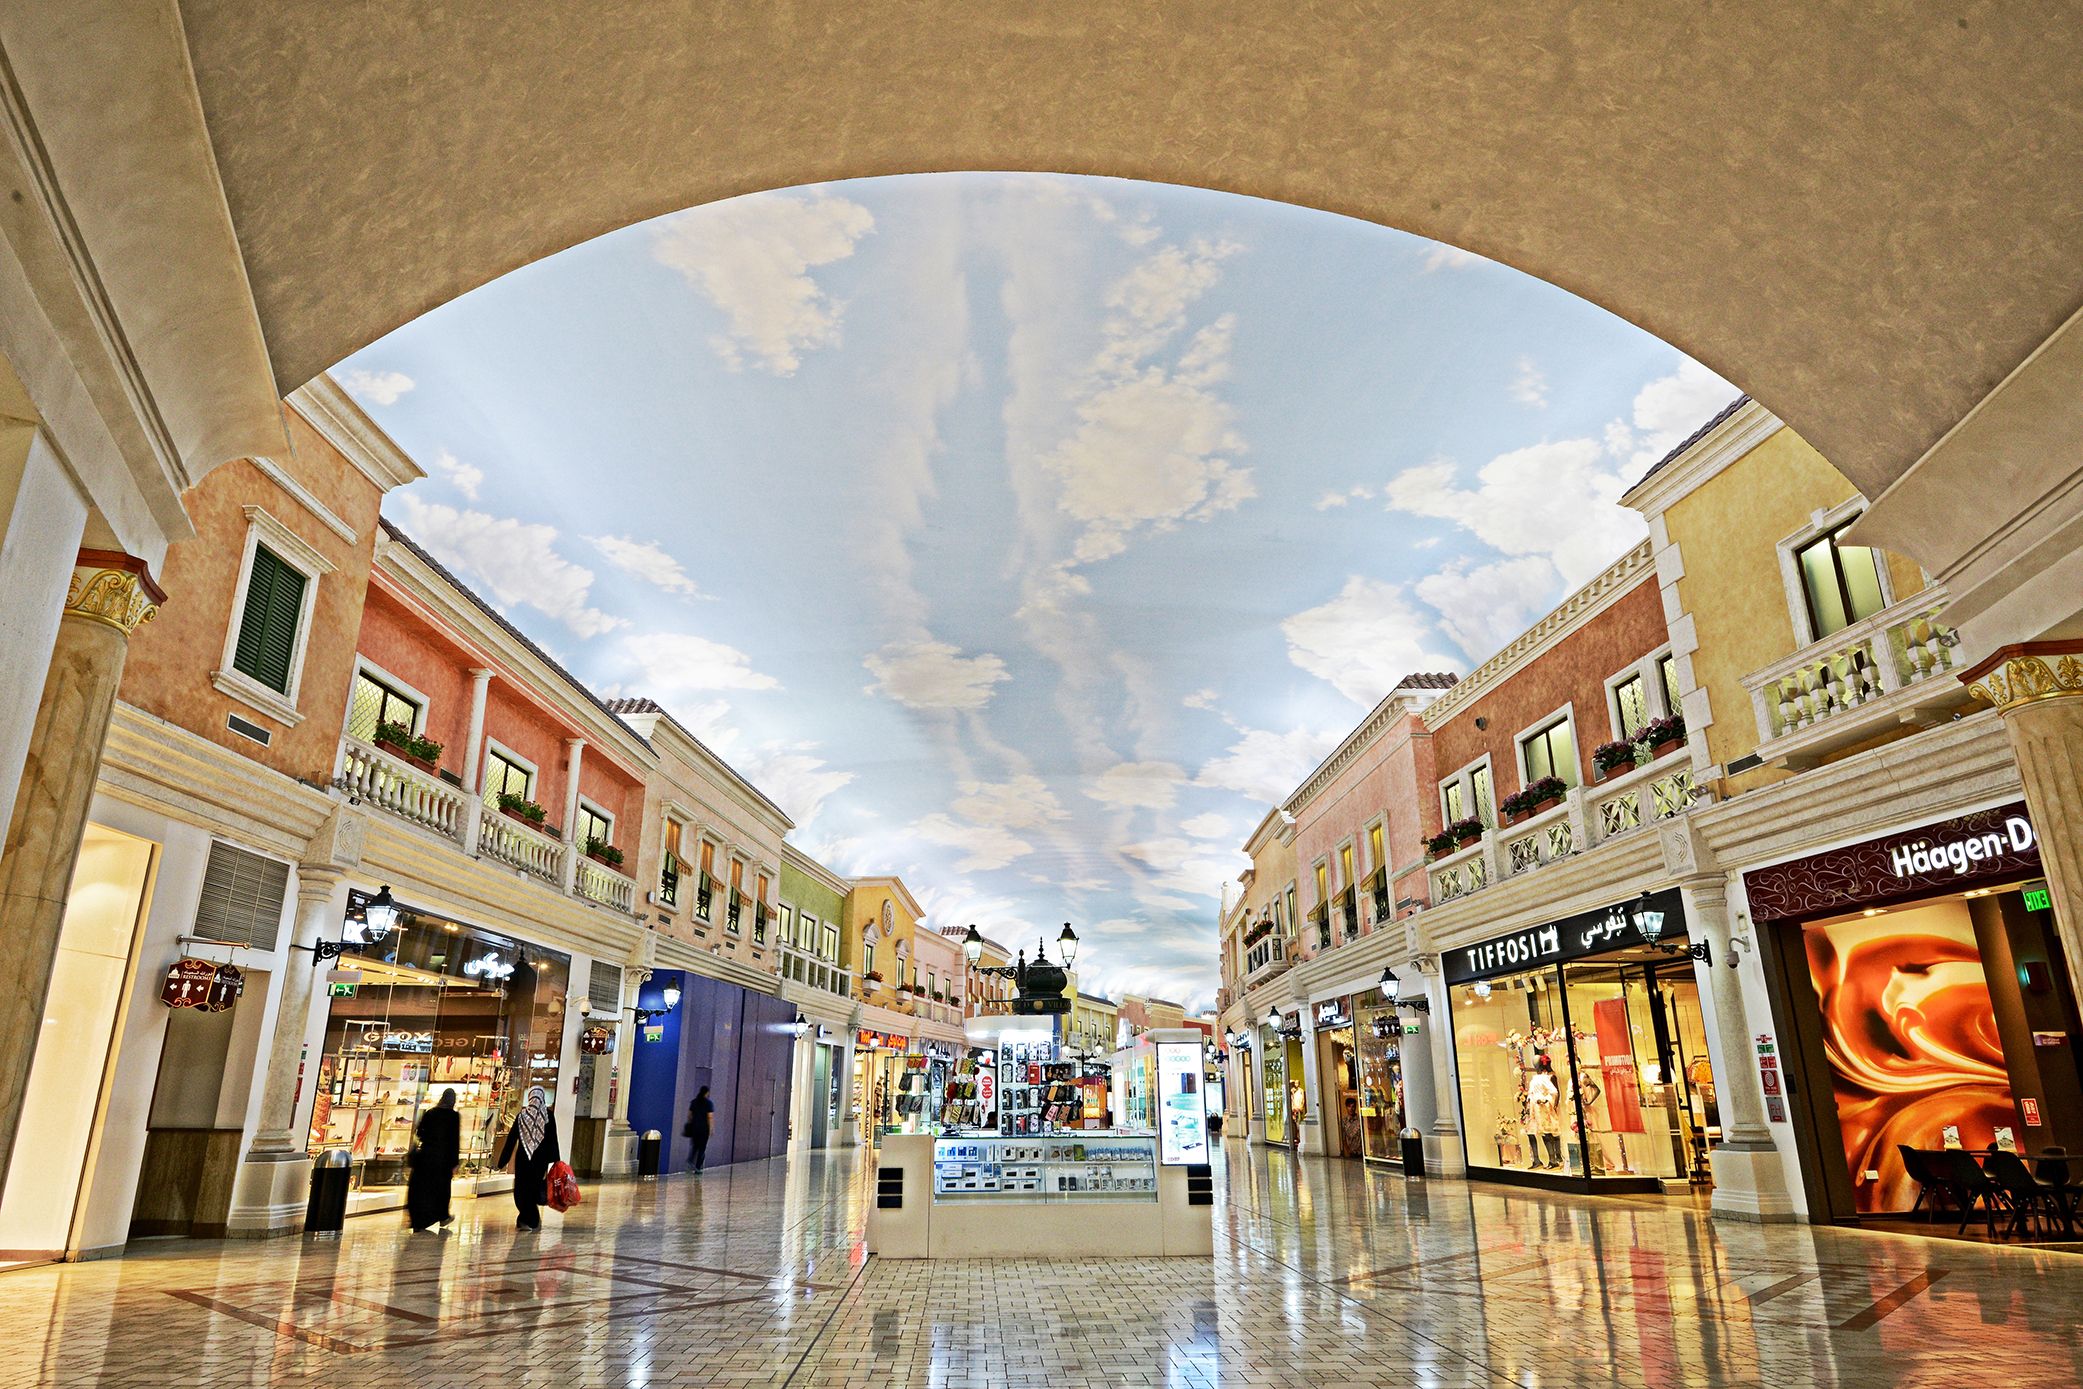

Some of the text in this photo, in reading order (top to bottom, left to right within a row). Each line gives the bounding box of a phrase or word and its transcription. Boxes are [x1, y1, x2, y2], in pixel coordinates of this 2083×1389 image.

[1890, 817, 2037, 878] Häagen-D
[1580, 906, 1628, 948] تيفوسي
[1467, 933, 1538, 972] TIFFOSI
